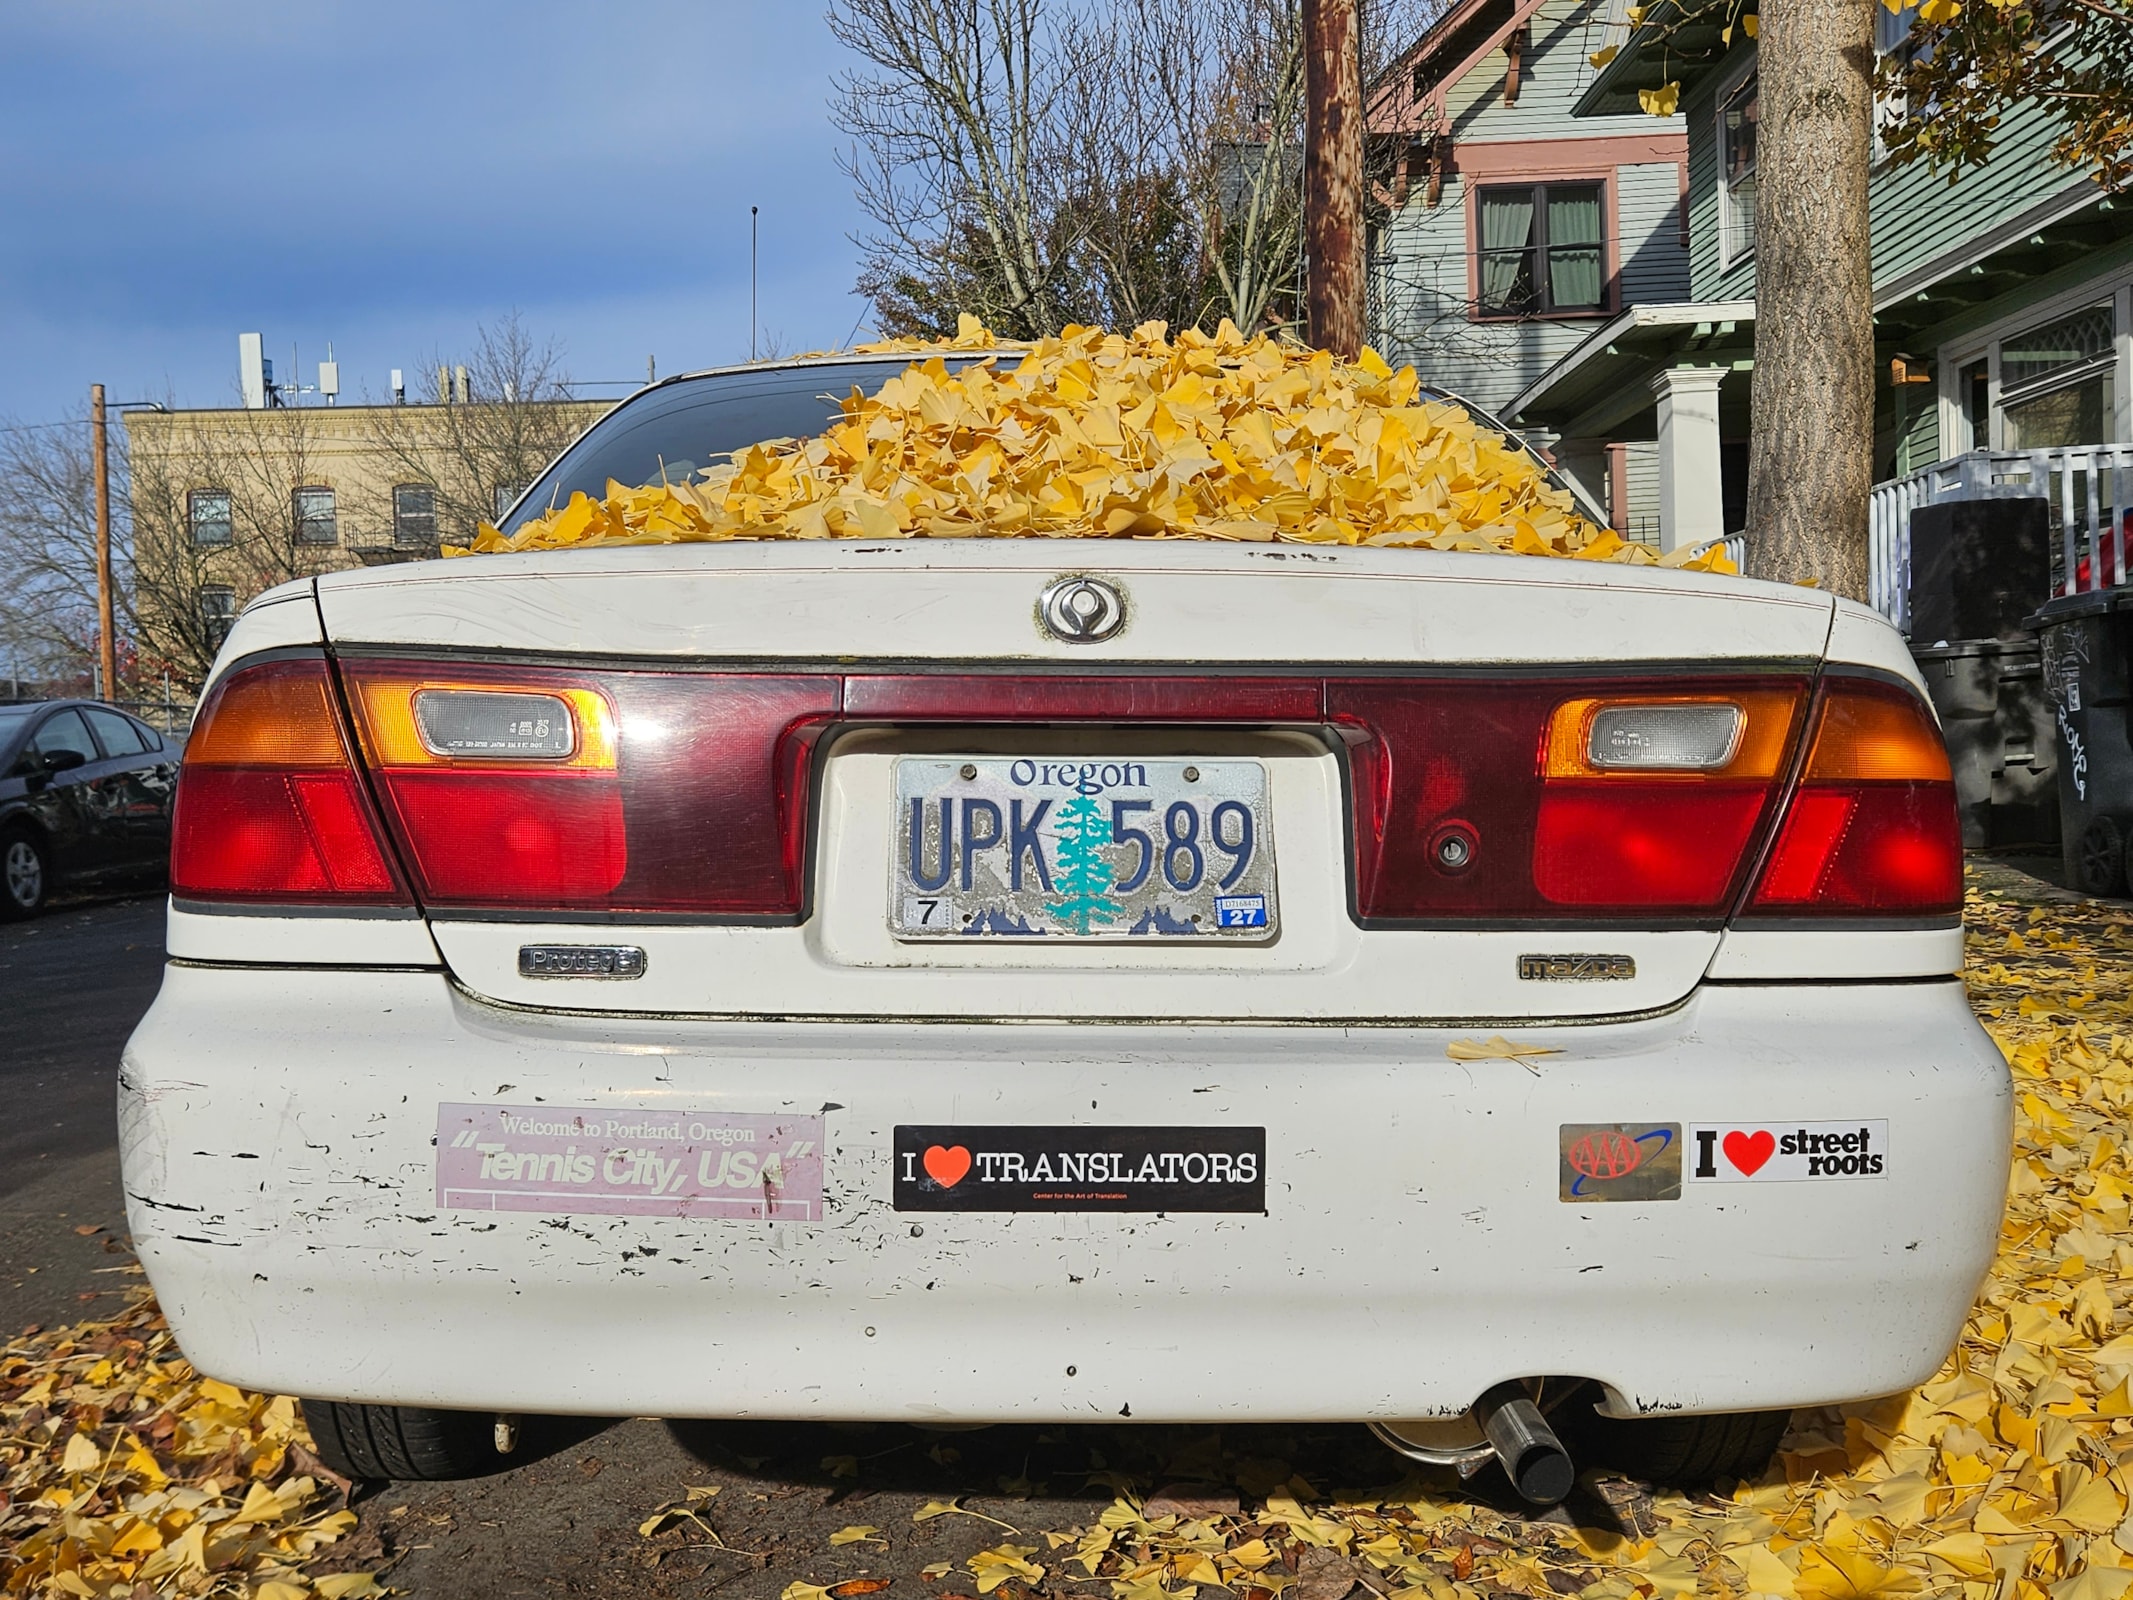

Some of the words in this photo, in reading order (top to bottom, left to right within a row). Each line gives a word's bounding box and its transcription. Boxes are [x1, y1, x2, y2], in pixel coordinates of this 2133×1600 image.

[1009, 759, 1150, 796] Oregon
[910, 797, 1055, 893] UPK
[1112, 800, 1255, 894] 589
[917, 900, 939, 925] 7
[1230, 909, 1257, 925] 27
[500, 1115, 580, 1137] Welcome
[583, 1122, 601, 1137] to
[605, 1120, 684, 1142] Portland,
[688, 1124, 756, 1148] Oregon
[902, 1152, 917, 1182] I
[975, 1152, 1258, 1183] TRANSLATORS
[1575, 1132, 1637, 1178] AAA
[1695, 1130, 1717, 1178] I
[1780, 1127, 1870, 1155] street
[1808, 1152, 1883, 1176] roots
[602, 1147, 690, 1195] City,
[1032, 1192, 1053, 1200] Center
[1054, 1192, 1063, 1200] for
[1064, 1192, 1075, 1200] the
[1075, 1192, 1086, 1200] Art
[1086, 1192, 1094, 1200] of
[1095, 1192, 1128, 1200] Translation
